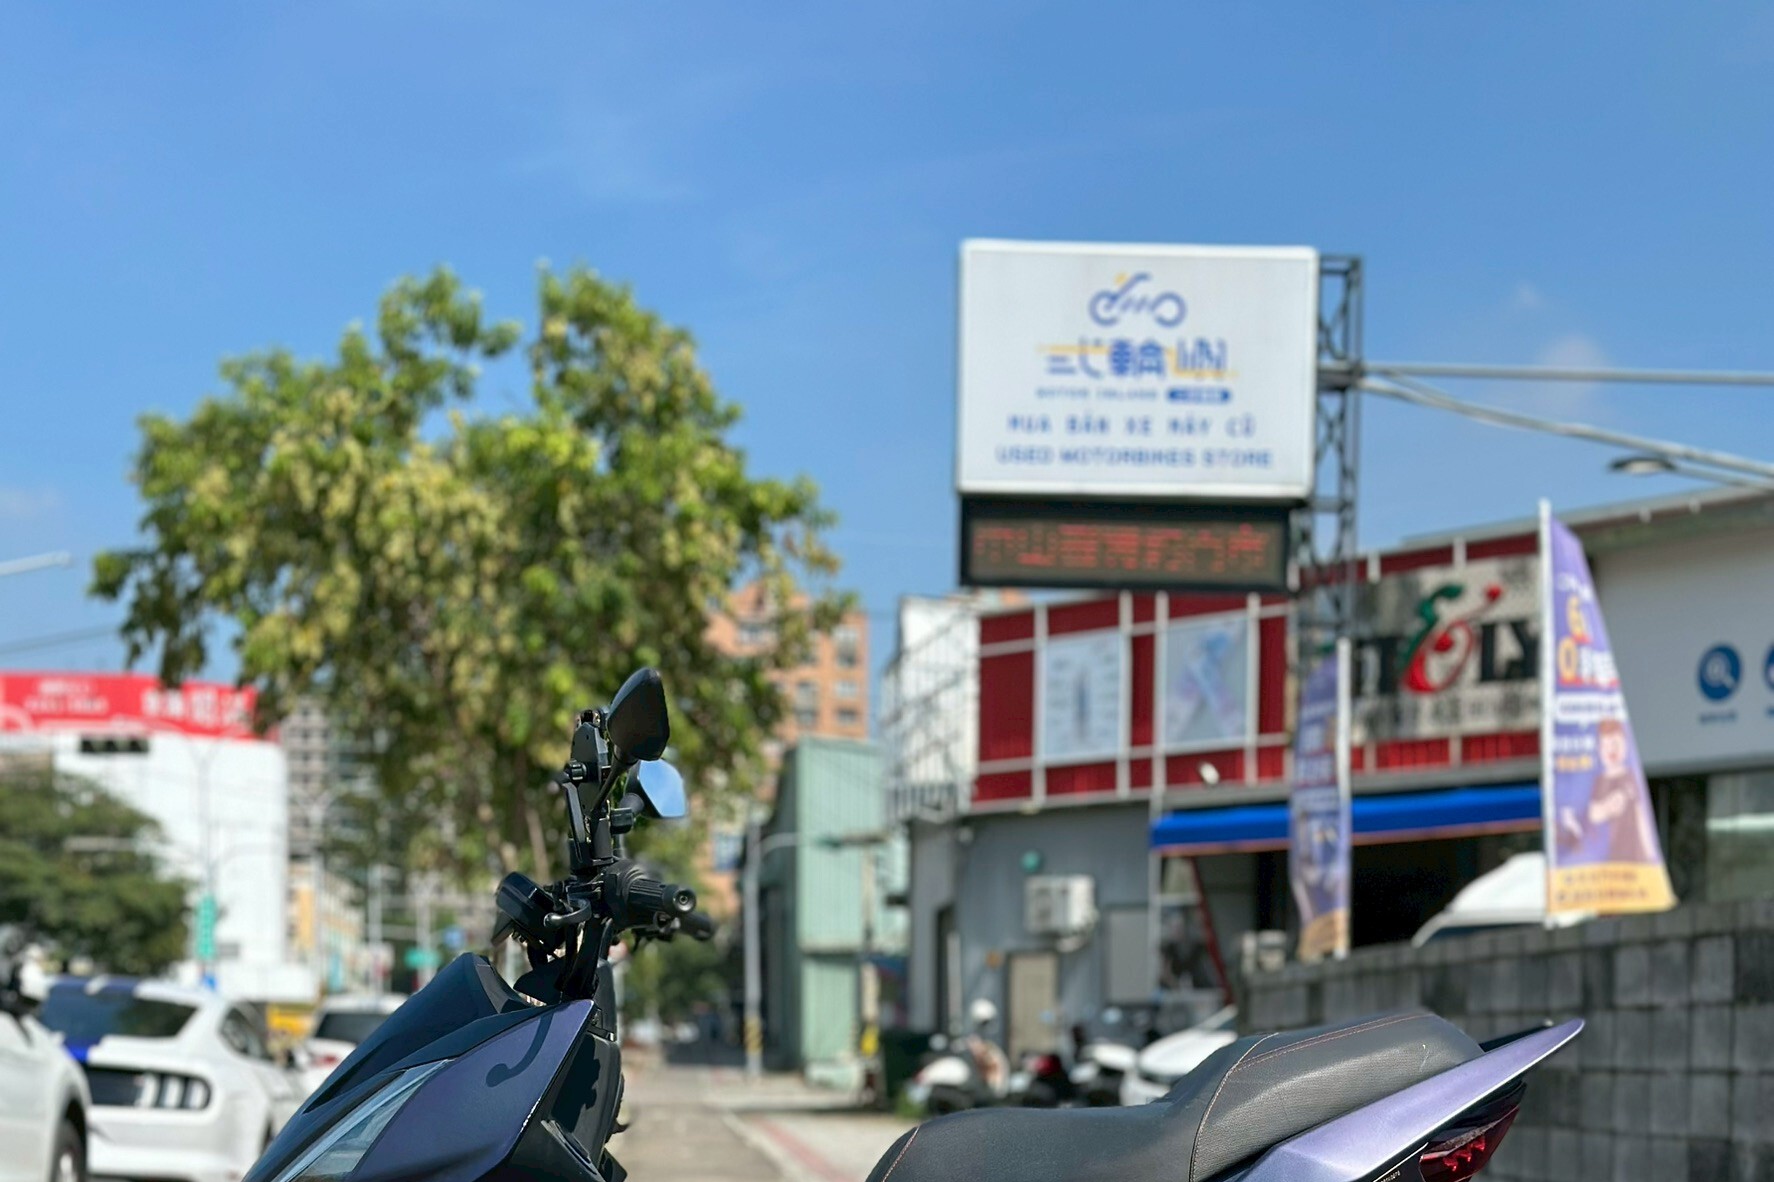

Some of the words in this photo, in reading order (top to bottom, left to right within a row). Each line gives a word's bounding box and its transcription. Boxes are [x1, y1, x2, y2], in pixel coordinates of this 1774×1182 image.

[995, 446, 1053, 465] USED
[1059, 446, 1195, 468] MOTORBIKES
[1202, 448, 1273, 469] STORE
